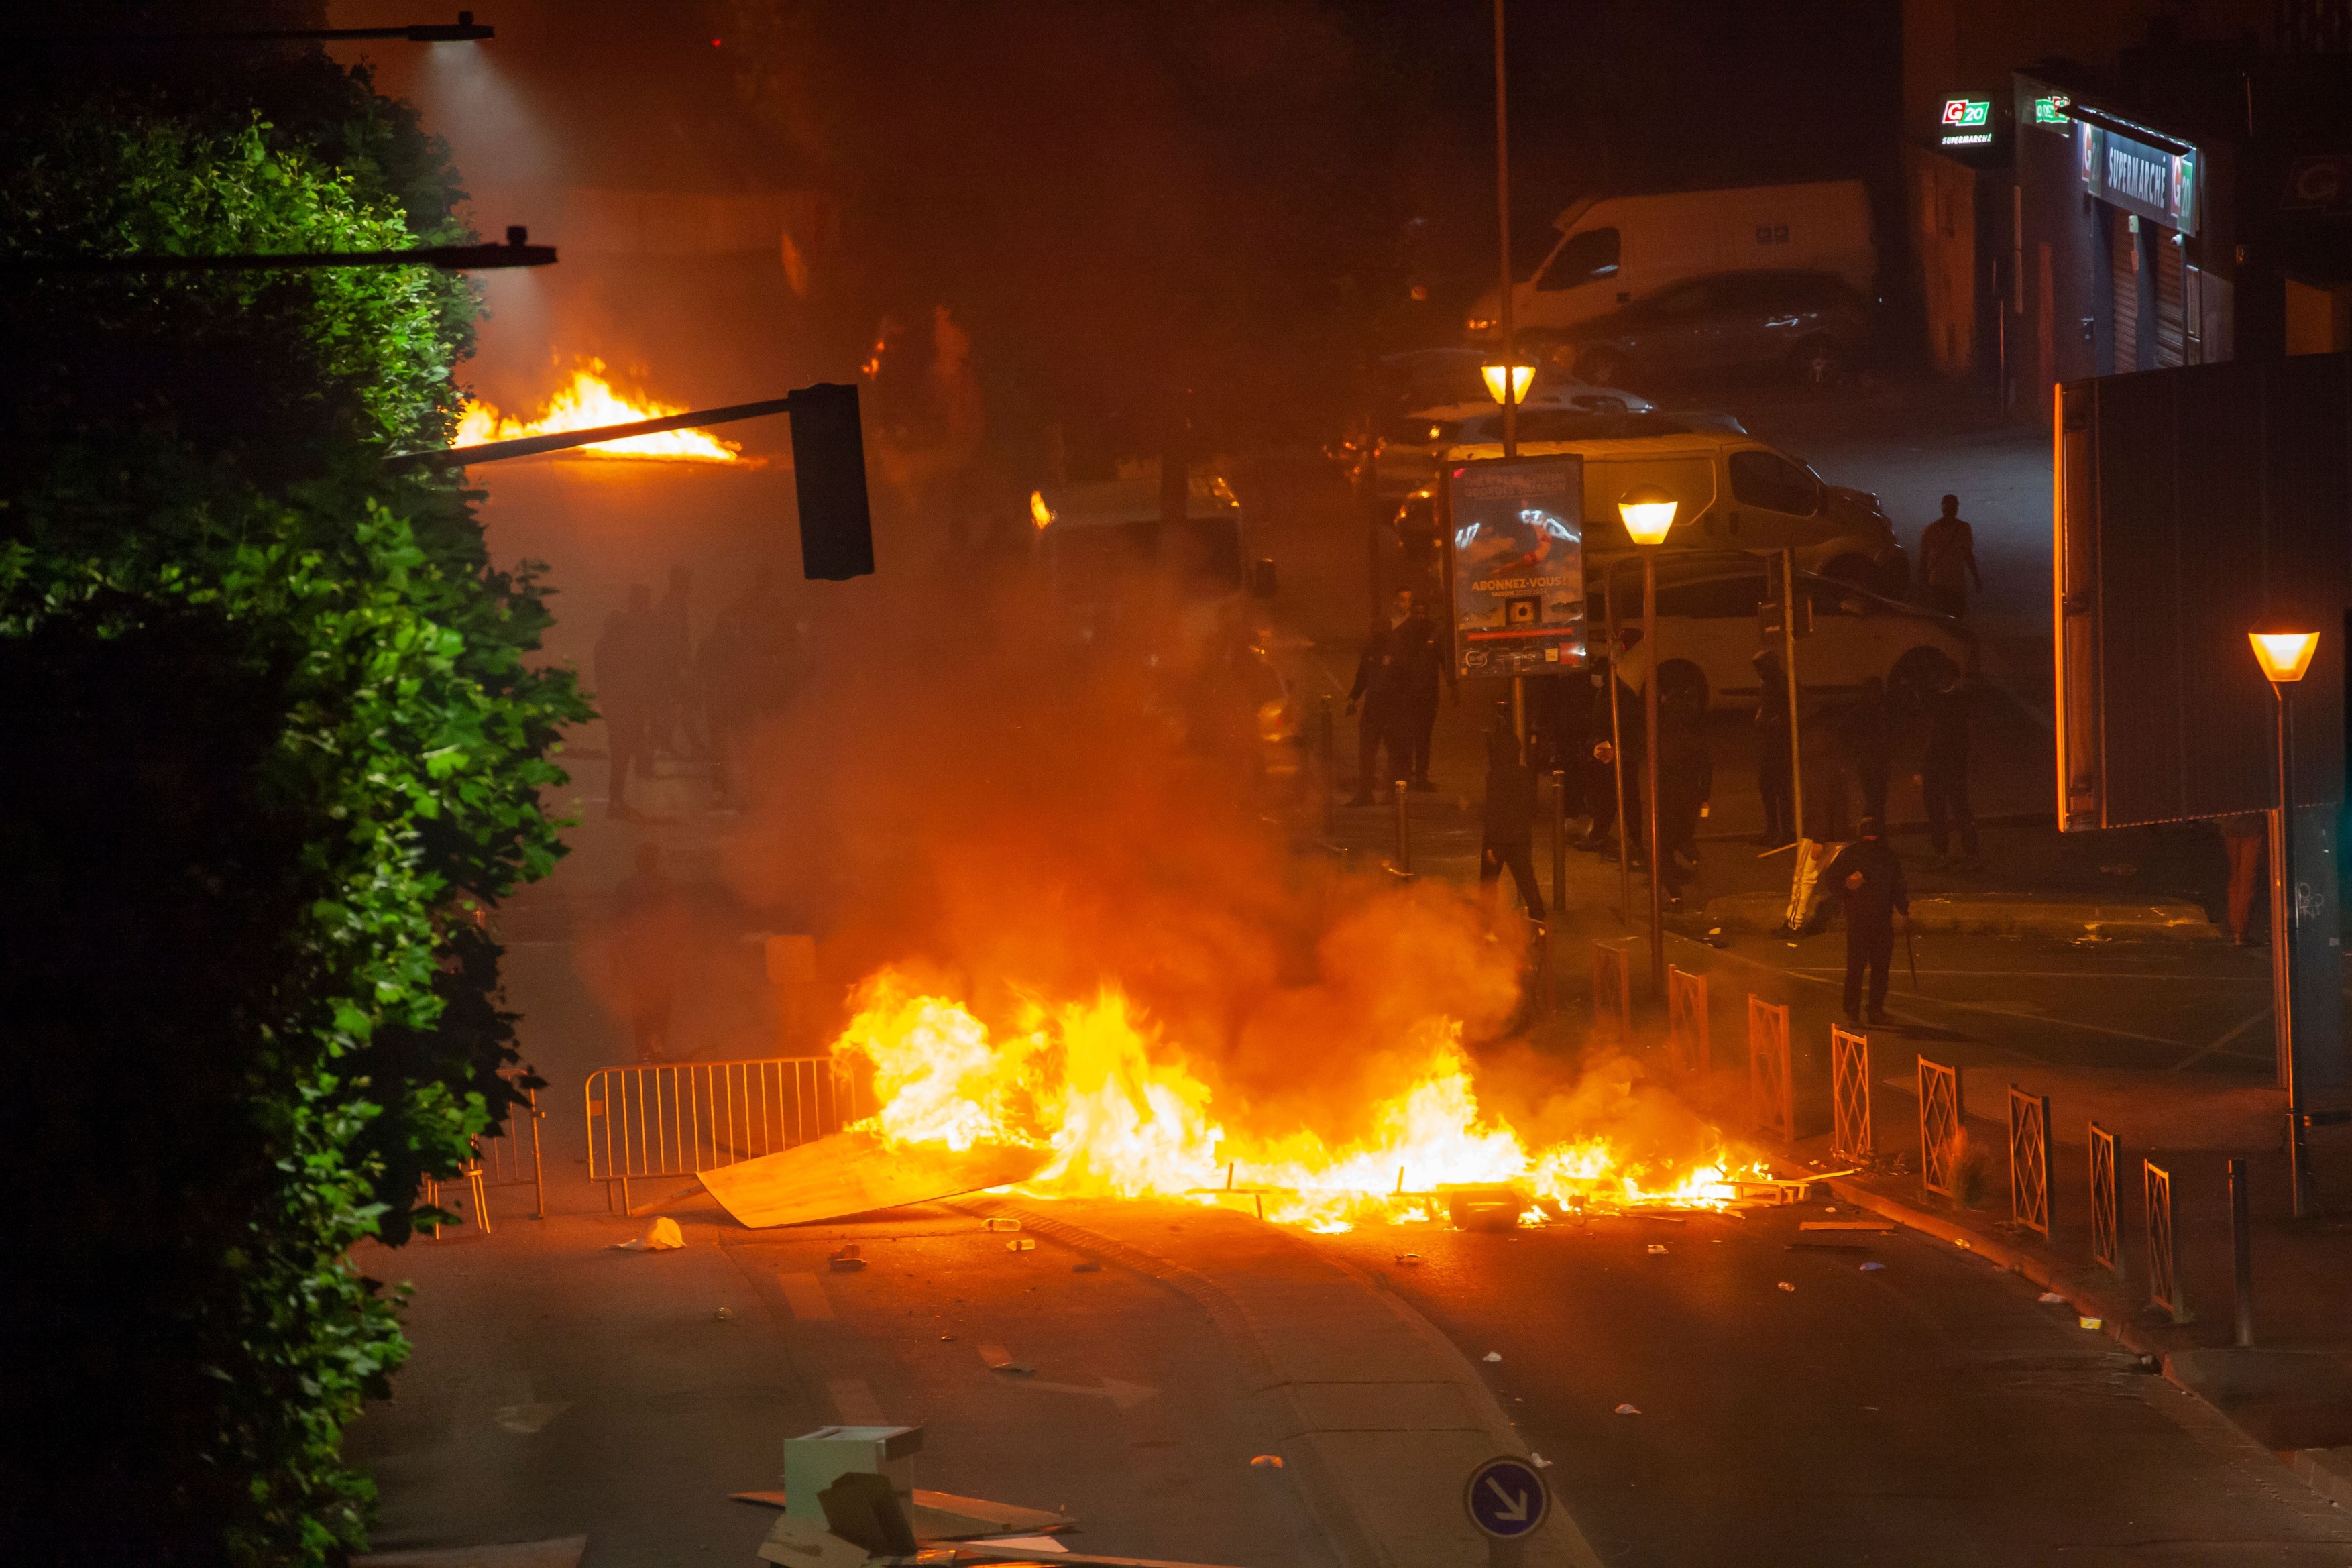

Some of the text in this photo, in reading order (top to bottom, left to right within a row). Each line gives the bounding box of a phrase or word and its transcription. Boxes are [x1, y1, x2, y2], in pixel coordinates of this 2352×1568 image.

[1947, 103, 1984, 121] G20
[1942, 133, 1992, 144] SUPERMARCHÉ
[2108, 146, 2166, 209] SUPERMARCHÉ
[2173, 156, 2190, 218] G20
[1471, 576, 1561, 591] ABONNEZ-VOUS
